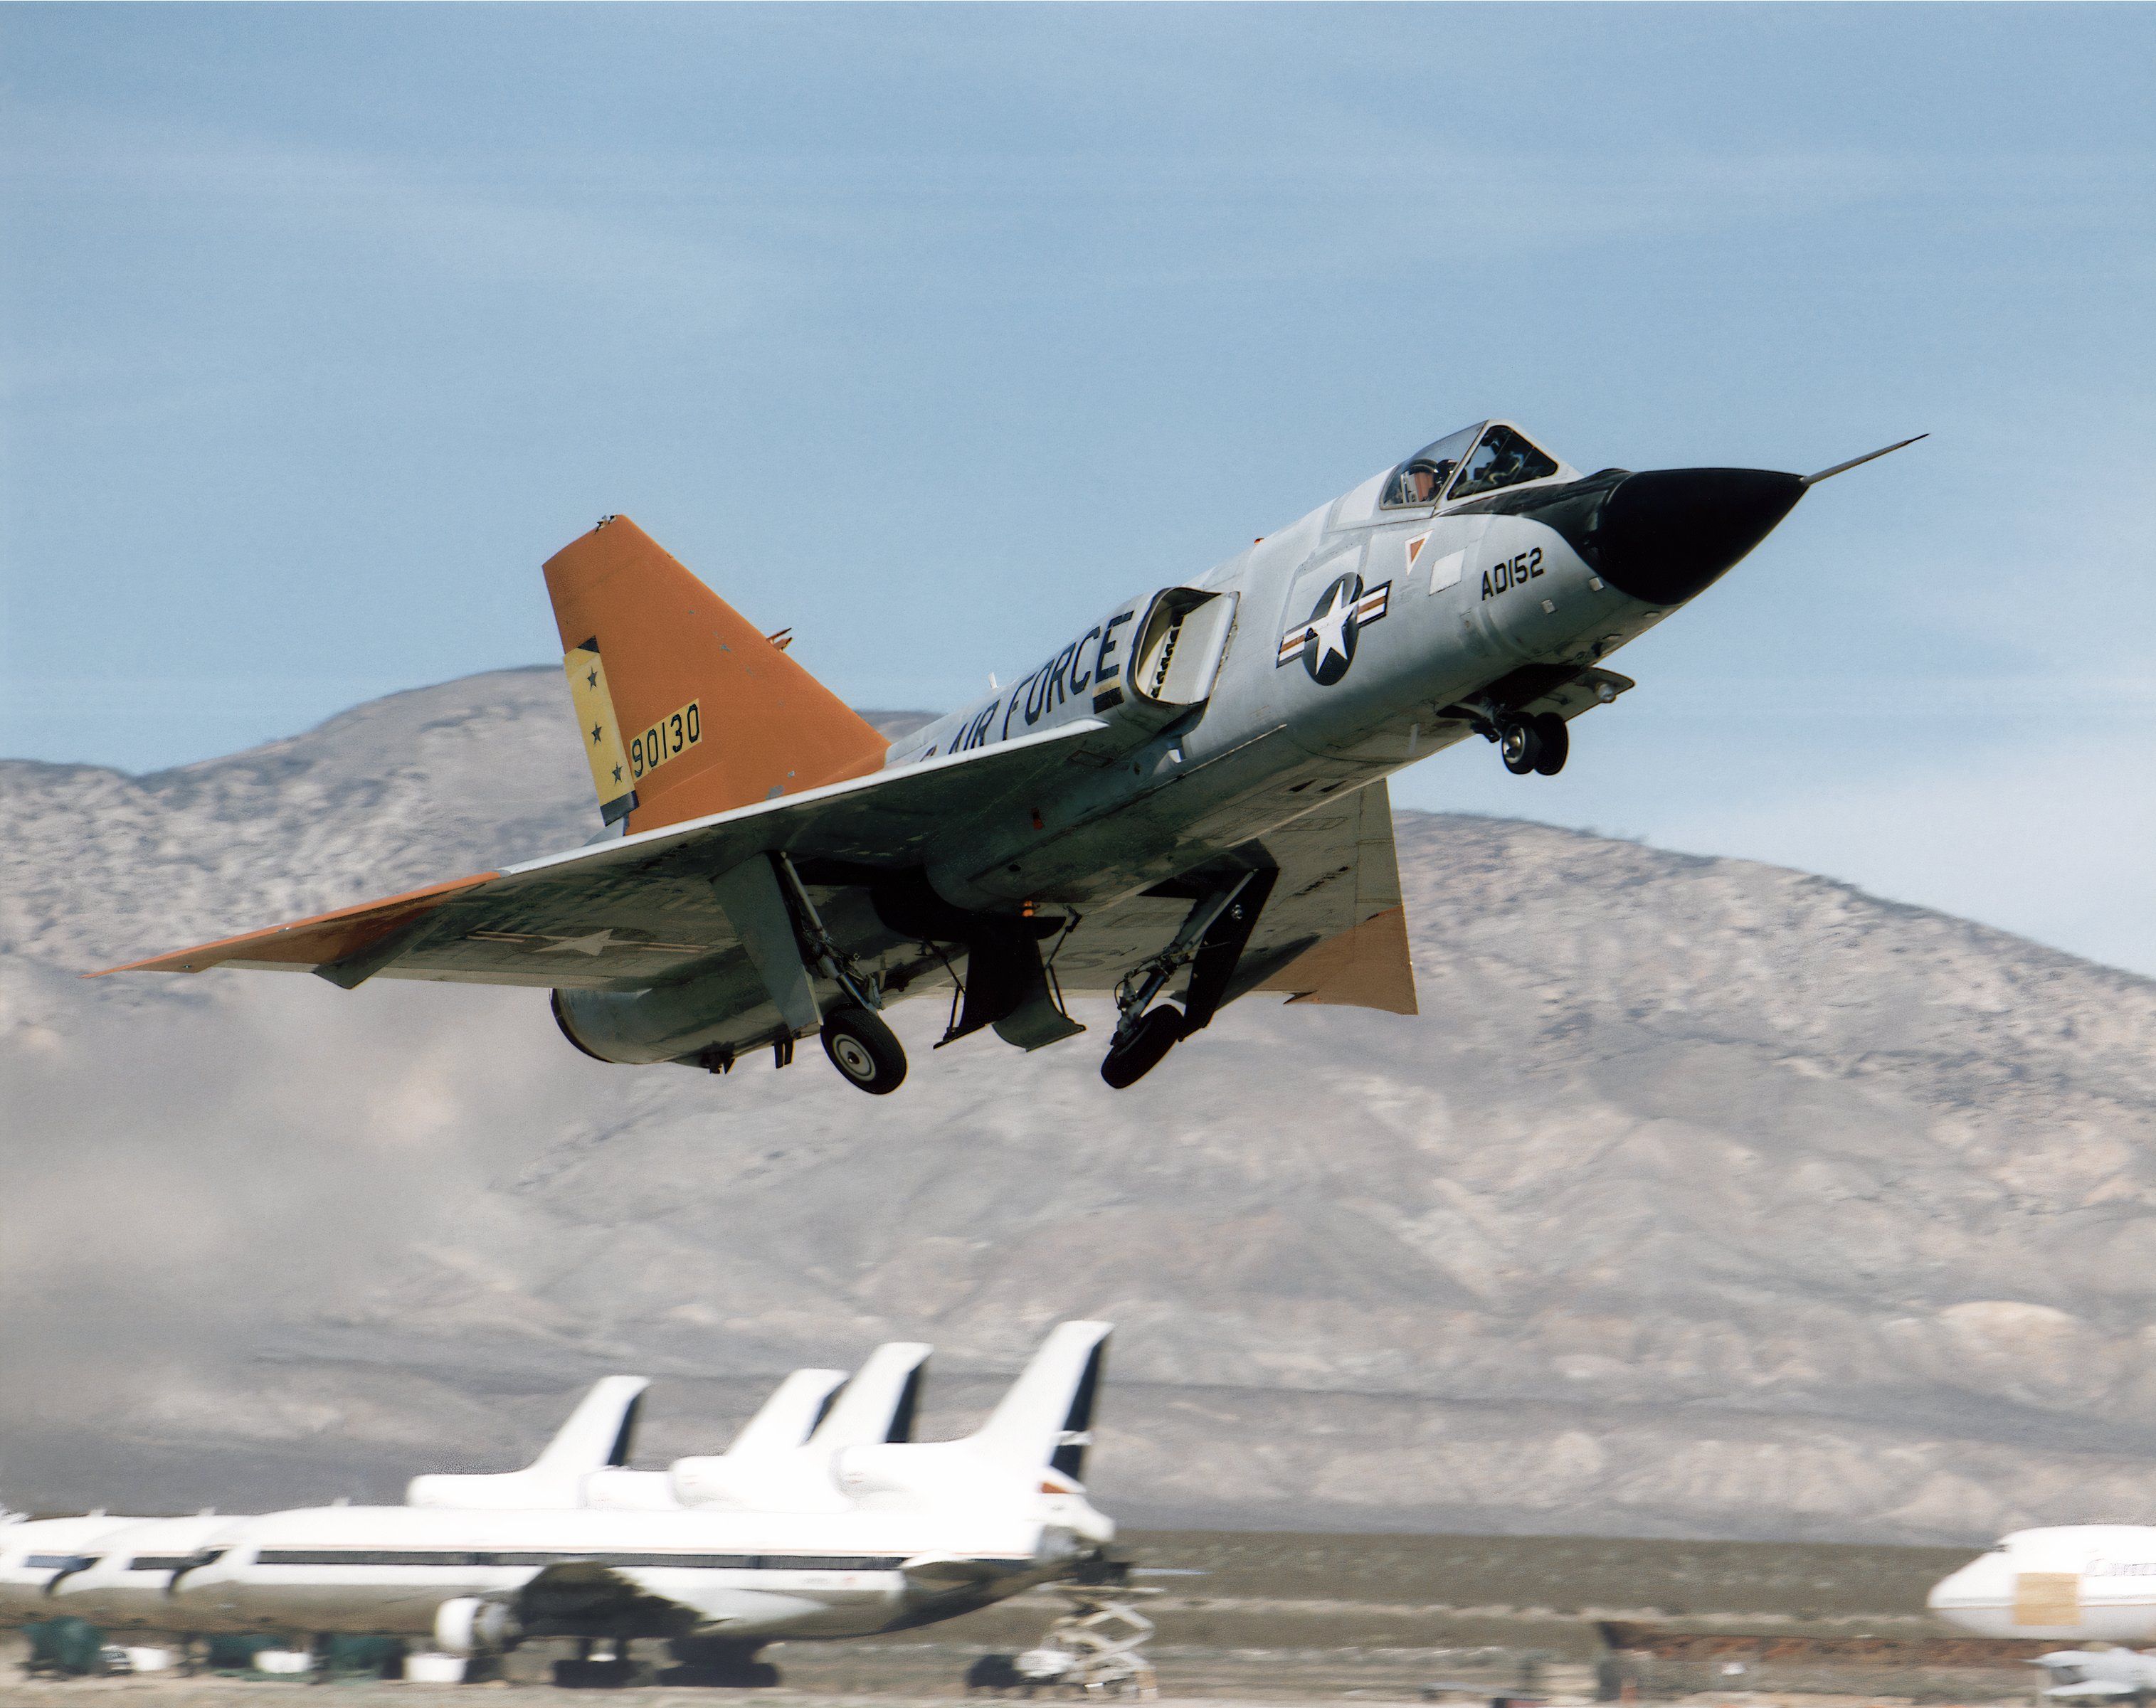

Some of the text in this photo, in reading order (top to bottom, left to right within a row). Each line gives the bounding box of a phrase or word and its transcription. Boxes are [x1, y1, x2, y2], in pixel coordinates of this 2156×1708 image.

[1482, 547, 1544, 601] AD152
[948, 610, 1134, 755] AIR FORCE
[631, 704, 699, 778] 90130
